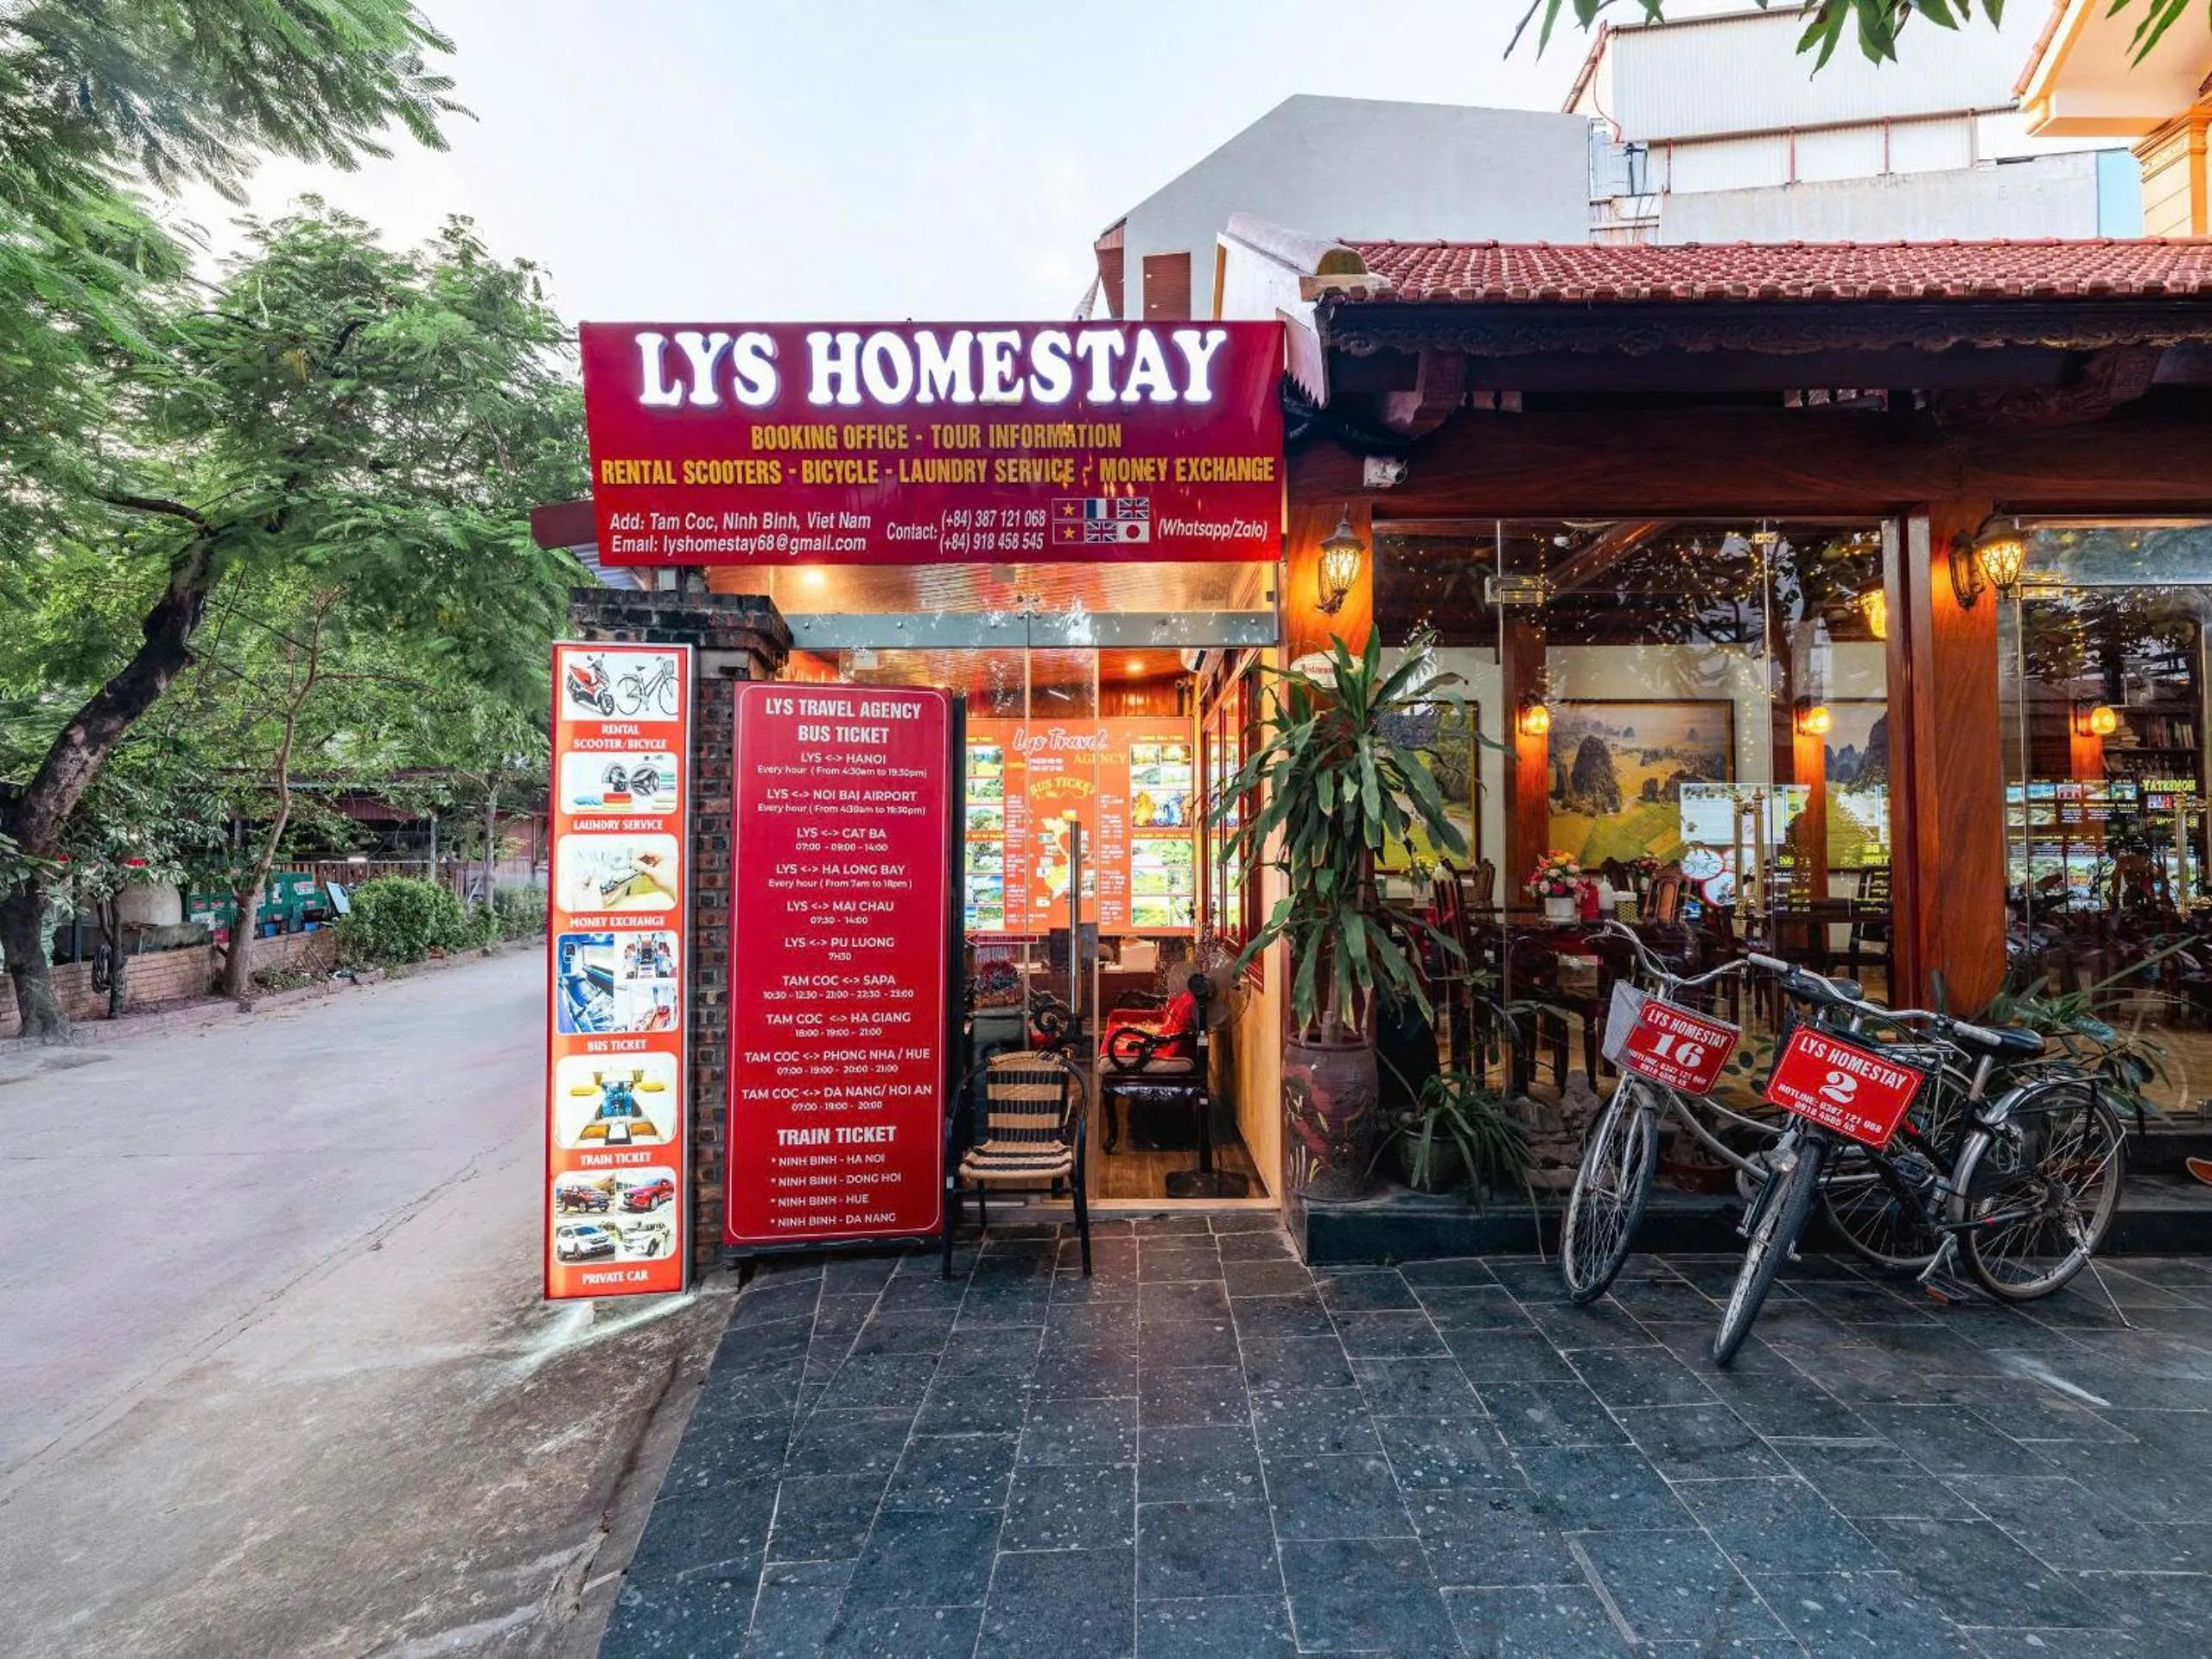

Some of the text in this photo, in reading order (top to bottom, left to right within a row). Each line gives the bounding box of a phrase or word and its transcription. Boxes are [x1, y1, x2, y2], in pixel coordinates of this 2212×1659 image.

[635, 330, 1227, 406] LYS HOMESTAY
[752, 423, 1121, 450] BOOKING OFFICE TOUR INFORMATION
[601, 457, 1274, 485] RENTAL SCOOTERS BICYCLE LAUNDRY SERVICE MONEY EXCHANGE
[610, 512, 645, 531] Add:
[650, 512, 679, 530] Tam
[685, 512, 718, 533] Coc,
[807, 512, 835, 529] Viet
[839, 512, 871, 529] Nam
[941, 510, 1046, 528] (+84) 387 121 068
[887, 522, 938, 541] Contact:
[1158, 518, 1268, 543] (Whatsapp/Zalo)
[612, 533, 866, 556] Email: lyshomestay68@gmail.com
[939, 531, 1044, 553] (+84) 918 458 545
[766, 698, 921, 719] LYS TRAVEL AGENCY
[601, 724, 639, 734] RENTAL
[798, 725, 889, 744] BUS TICKET
[573, 739, 667, 749] SCOOTER/BICYCLE
[801, 753, 886, 764] LYS HANOI
[758, 765, 784, 775] Every
[767, 790, 917, 801] LYS NOI BAI AIRPORT
[758, 804, 784, 813] Every
[573, 820, 664, 830] LAUNDRY SERVICE
[797, 828, 887, 838] LYS CAT BA
[865, 843, 888, 852] 14:00
[776, 864, 906, 874] LYS HA LONG BAY
[768, 880, 794, 889] Every
[796, 879, 817, 887] hour
[786, 901, 894, 912] LYS MAI CHAU
[570, 916, 664, 927] MONEY EXCHANGE
[785, 938, 895, 948] LYS PU LUONG
[828, 952, 851, 961] 7H30
[782, 975, 896, 986] TAM COC SAPA
[766, 1012, 911, 1025] TAM COC HA GIANG
[1647, 1008, 1728, 1049] LYS HOMESTAY
[588, 1039, 646, 1051] BUS TICKET
[1646, 1032, 1706, 1068] 16
[744, 1048, 930, 1063] TAM COC PHONG NHA HUE
[1799, 1036, 1908, 1091] LYS HOMESTAY
[741, 1089, 769, 1100] TAM
[772, 1088, 799, 1098] COC
[823, 1086, 842, 1097] DA
[888, 1085, 911, 1096] HOI
[913, 1084, 931, 1095] AN
[1819, 1071, 1859, 1104] 2
[777, 1126, 897, 1146] TRAIN TICKET
[580, 1153, 652, 1166] TRAIN TICKET
[779, 1154, 885, 1166] NINH BINH HA NOI
[779, 1173, 901, 1186] NINH BINH DONG HOI
[779, 1194, 869, 1207] NINH BINH HUE
[779, 1212, 896, 1228] NINH BINH DA NANG
[582, 1270, 649, 1284] PRIVATE CAR
